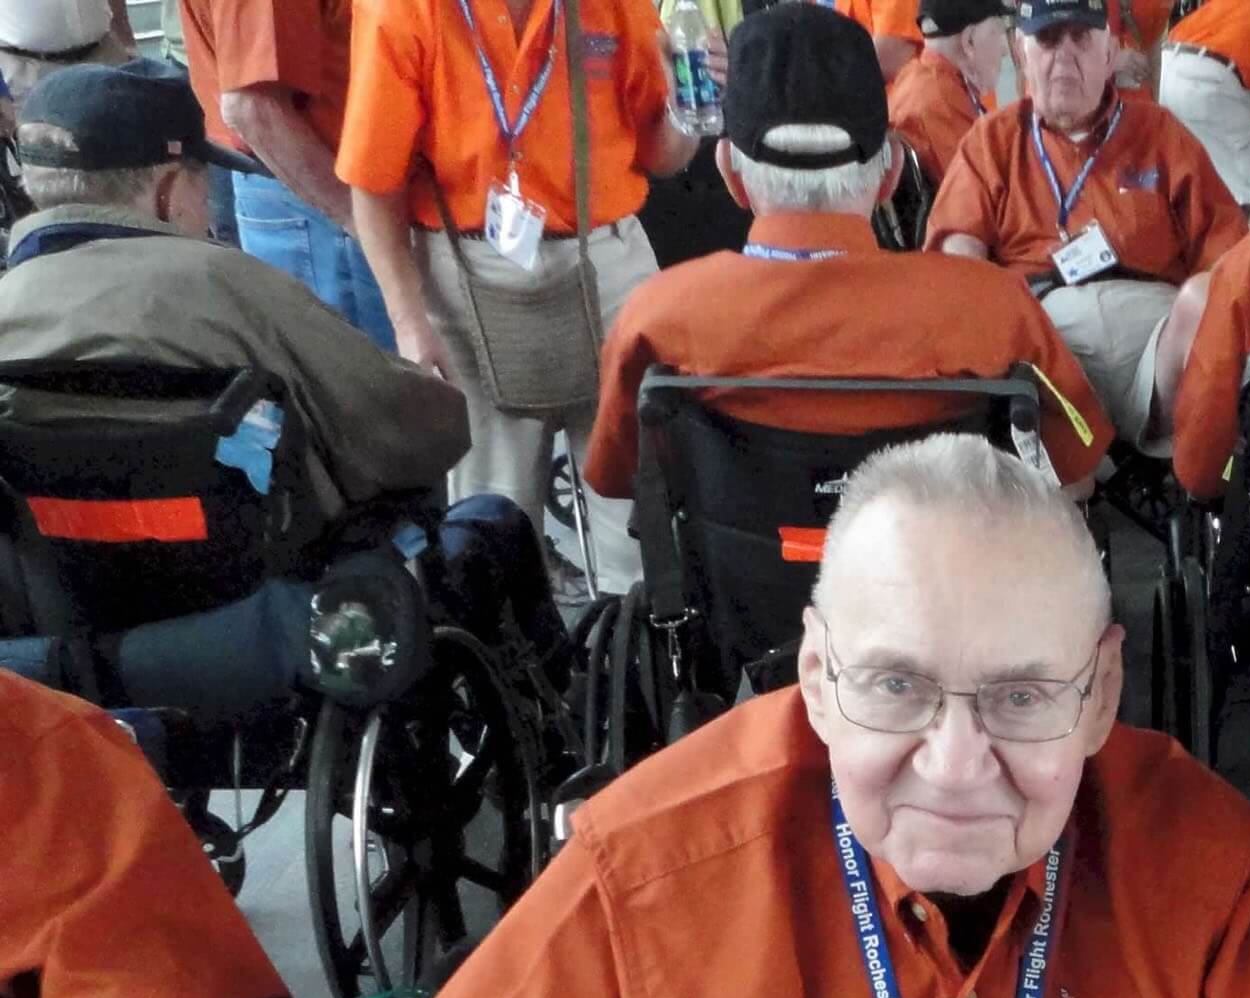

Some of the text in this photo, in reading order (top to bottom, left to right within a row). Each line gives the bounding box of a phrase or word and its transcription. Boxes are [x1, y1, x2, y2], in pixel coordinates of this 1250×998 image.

[835, 822, 860, 878] Honor
[850, 880, 875, 932] Flight
[1033, 849, 1061, 937] Rochester
[1023, 939, 1047, 990] Flight
